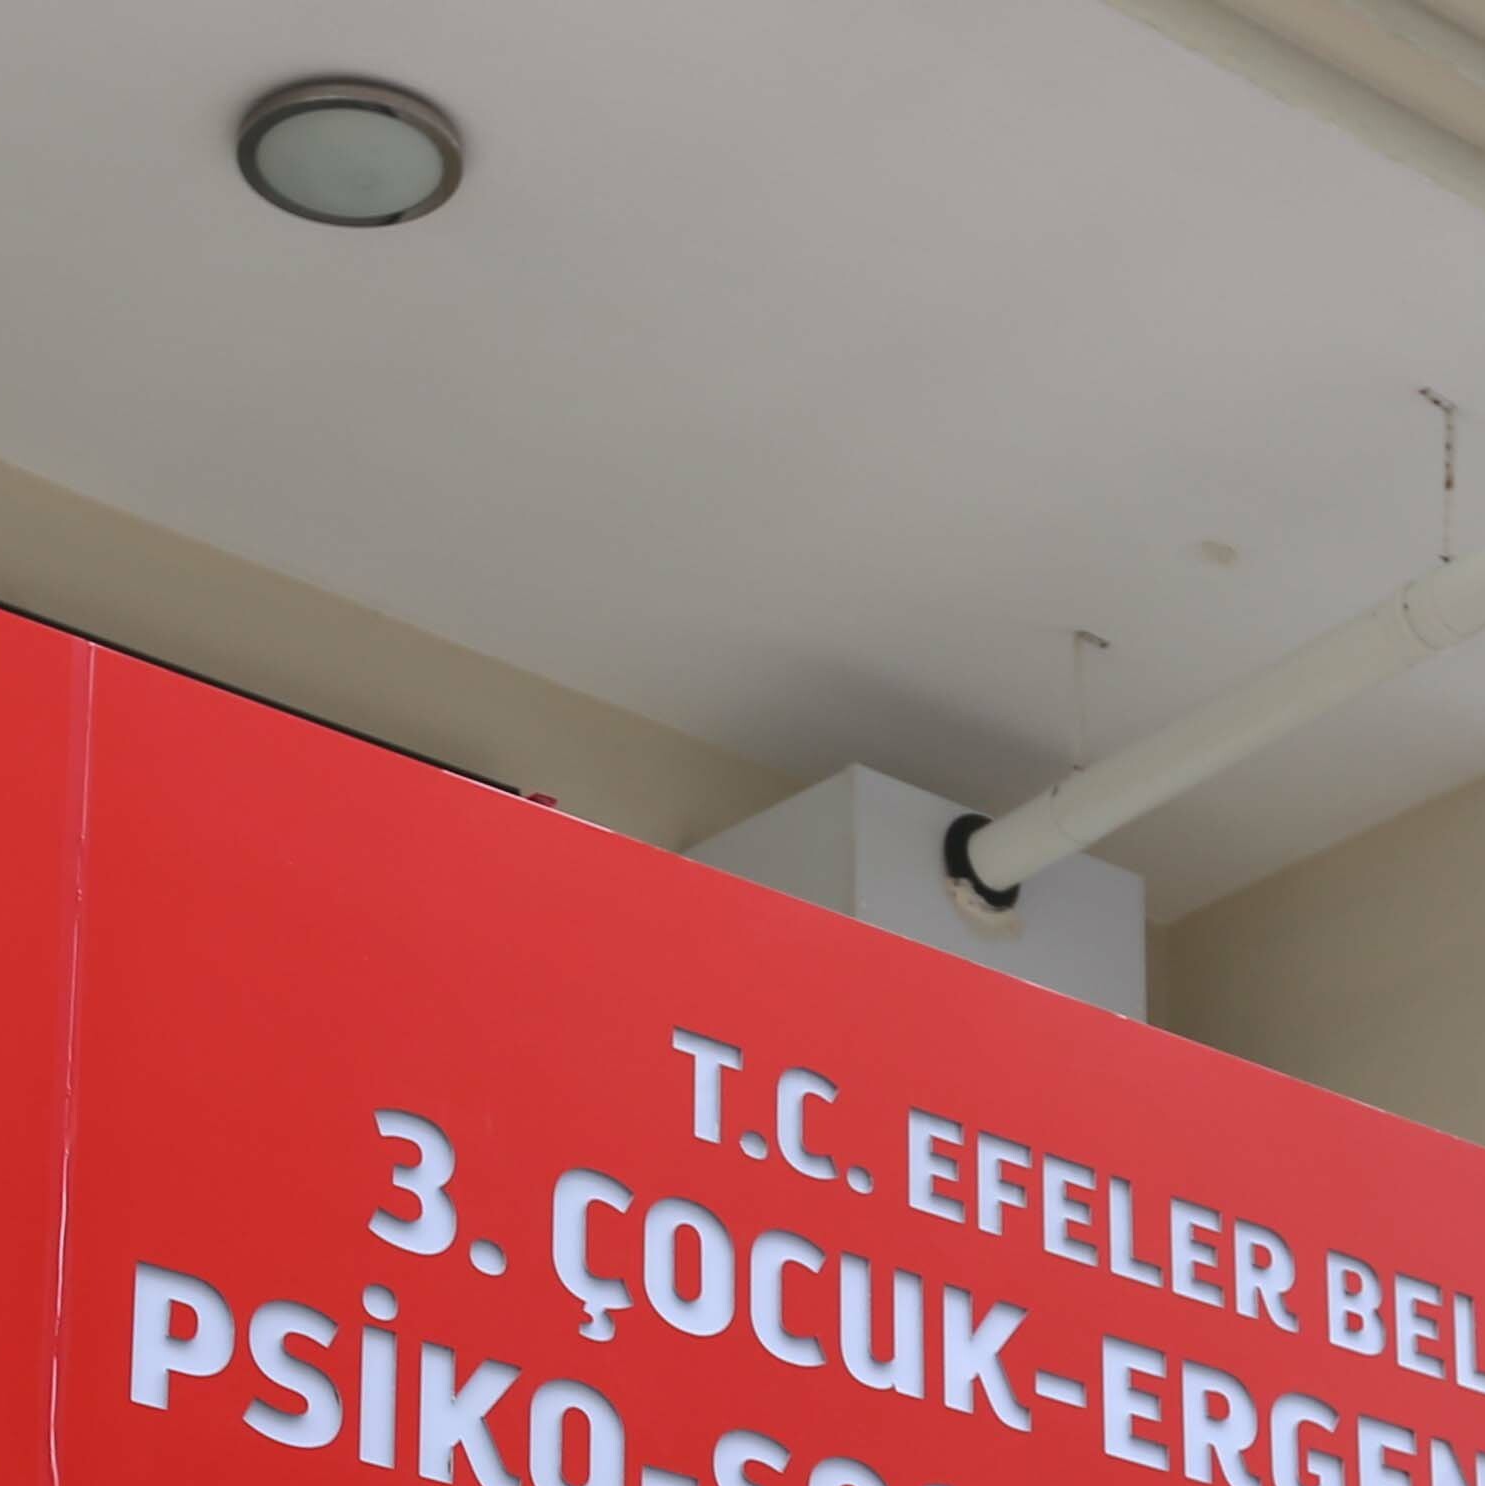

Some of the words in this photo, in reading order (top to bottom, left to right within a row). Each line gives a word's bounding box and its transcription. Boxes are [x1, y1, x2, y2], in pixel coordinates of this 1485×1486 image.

[367, 1108, 507, 1277] 3.
[672, 1027, 874, 1195] T.C.
[908, 1106, 1300, 1334] EFELER
